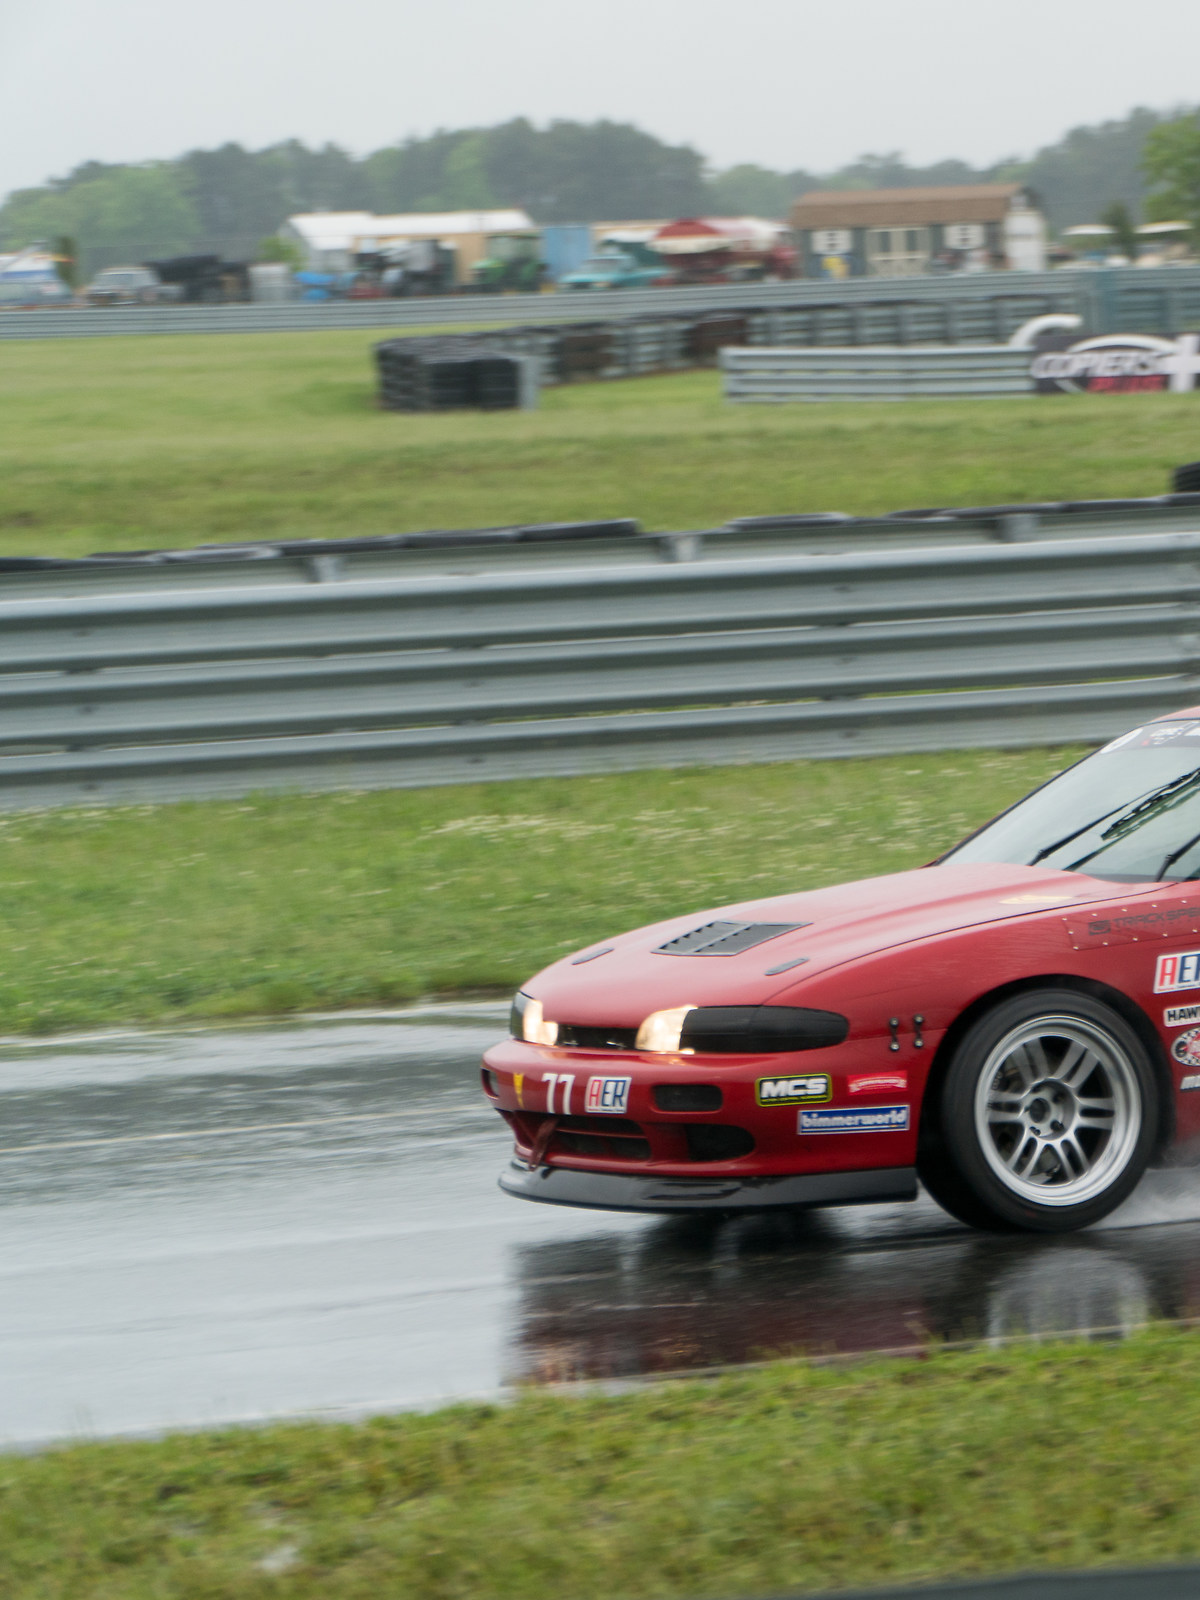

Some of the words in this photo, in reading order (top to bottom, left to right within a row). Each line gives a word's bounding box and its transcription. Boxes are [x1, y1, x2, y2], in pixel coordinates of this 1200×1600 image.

[541, 1072, 576, 1116] 77
[588, 1078, 627, 1108] AER
[760, 1077, 828, 1099] MCS
[802, 1109, 907, 1128] bimmerworld
